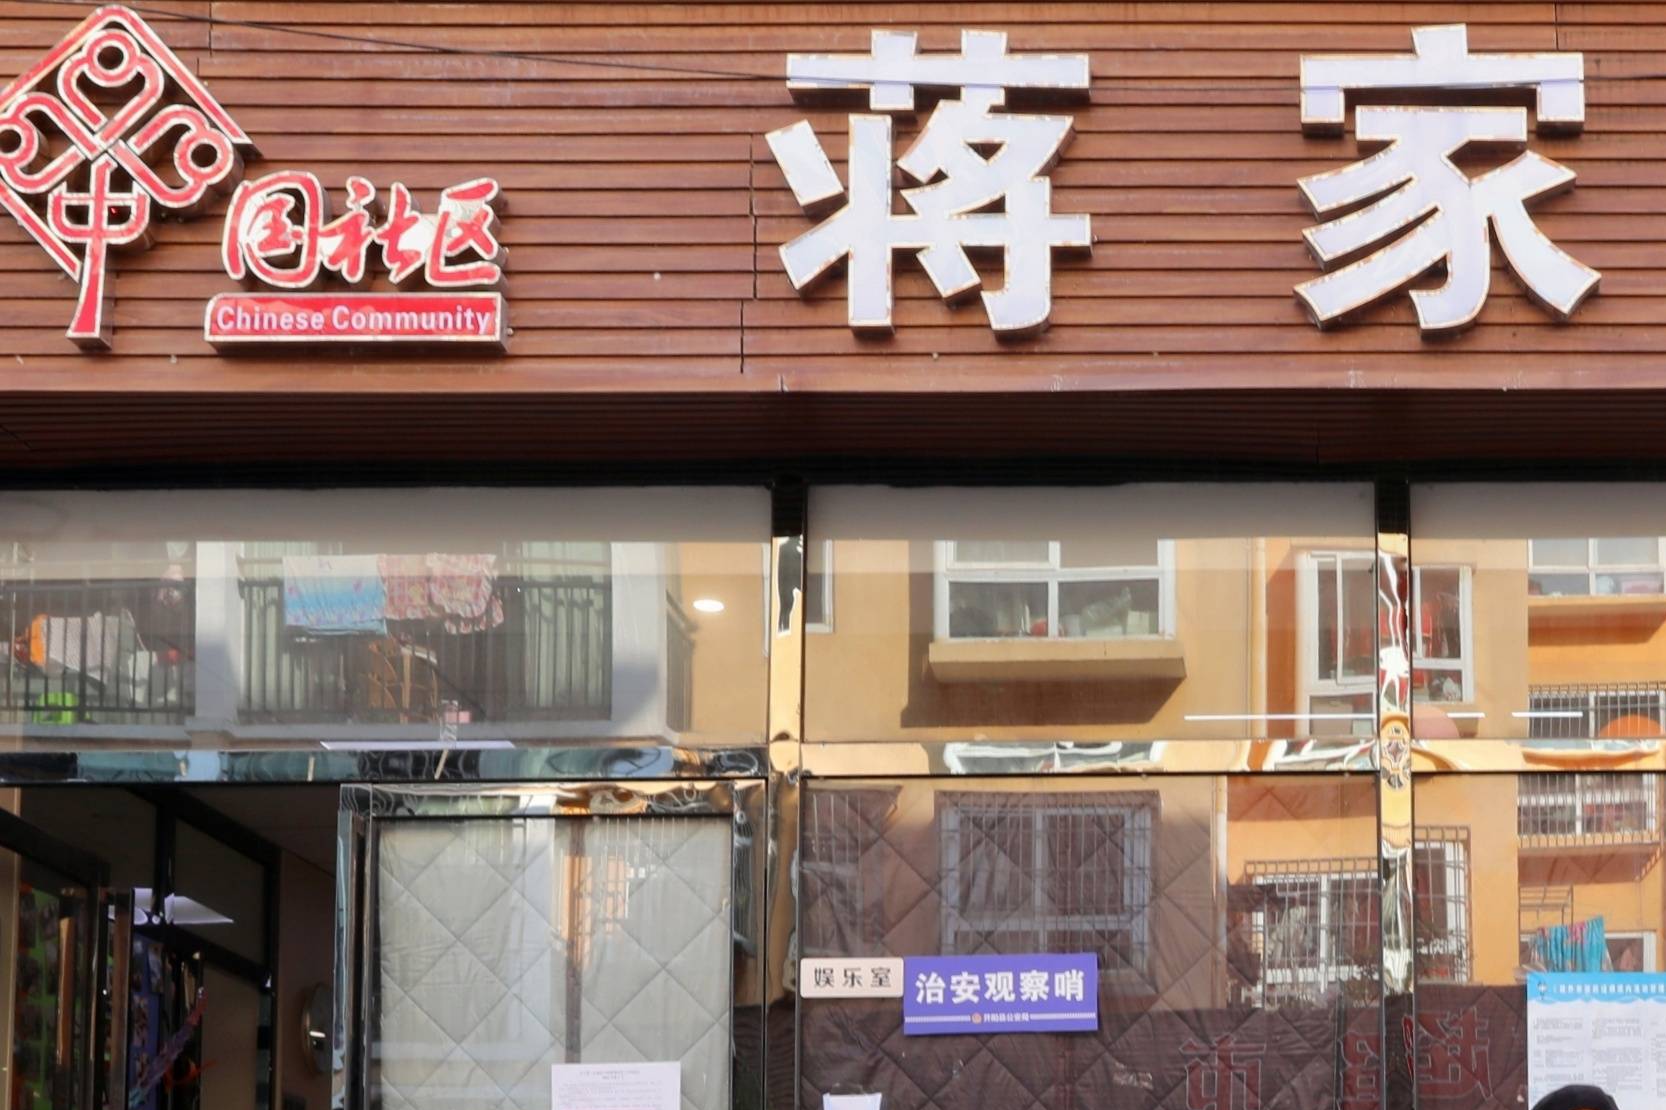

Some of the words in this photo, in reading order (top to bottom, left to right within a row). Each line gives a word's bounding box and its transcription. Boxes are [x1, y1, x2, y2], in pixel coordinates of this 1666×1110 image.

[216, 305, 325, 332] Chinese
[331, 305, 492, 335] Community
[814, 967, 891, 988] 娱乐室
[915, 969, 1085, 1004] 治安观察哨
